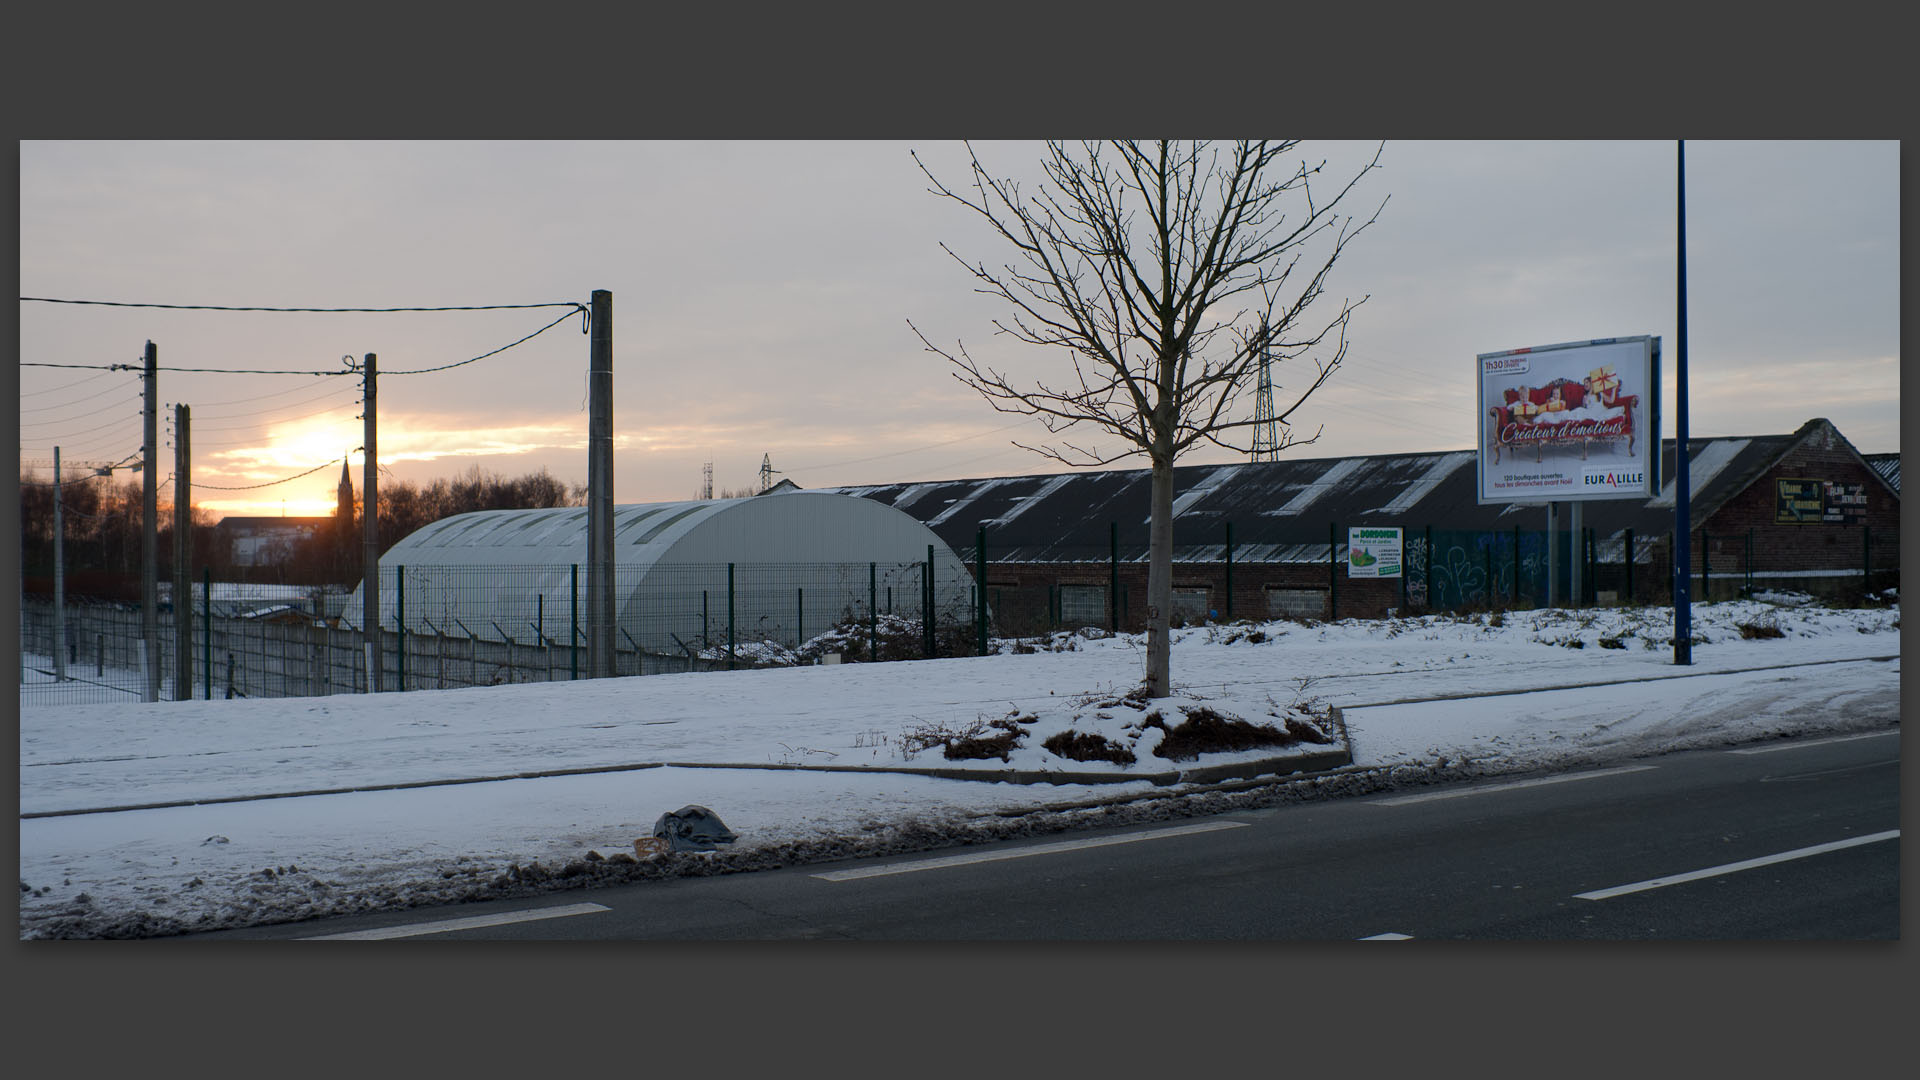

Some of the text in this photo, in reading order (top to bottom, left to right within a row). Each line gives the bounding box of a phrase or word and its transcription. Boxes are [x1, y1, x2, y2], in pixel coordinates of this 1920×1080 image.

[1485, 360, 1503, 370] 1h30
[1501, 420, 1624, 443] Créateur d'émotions
[1514, 473, 1539, 482] boutiques
[1584, 472, 1643, 488] EURALILLE
